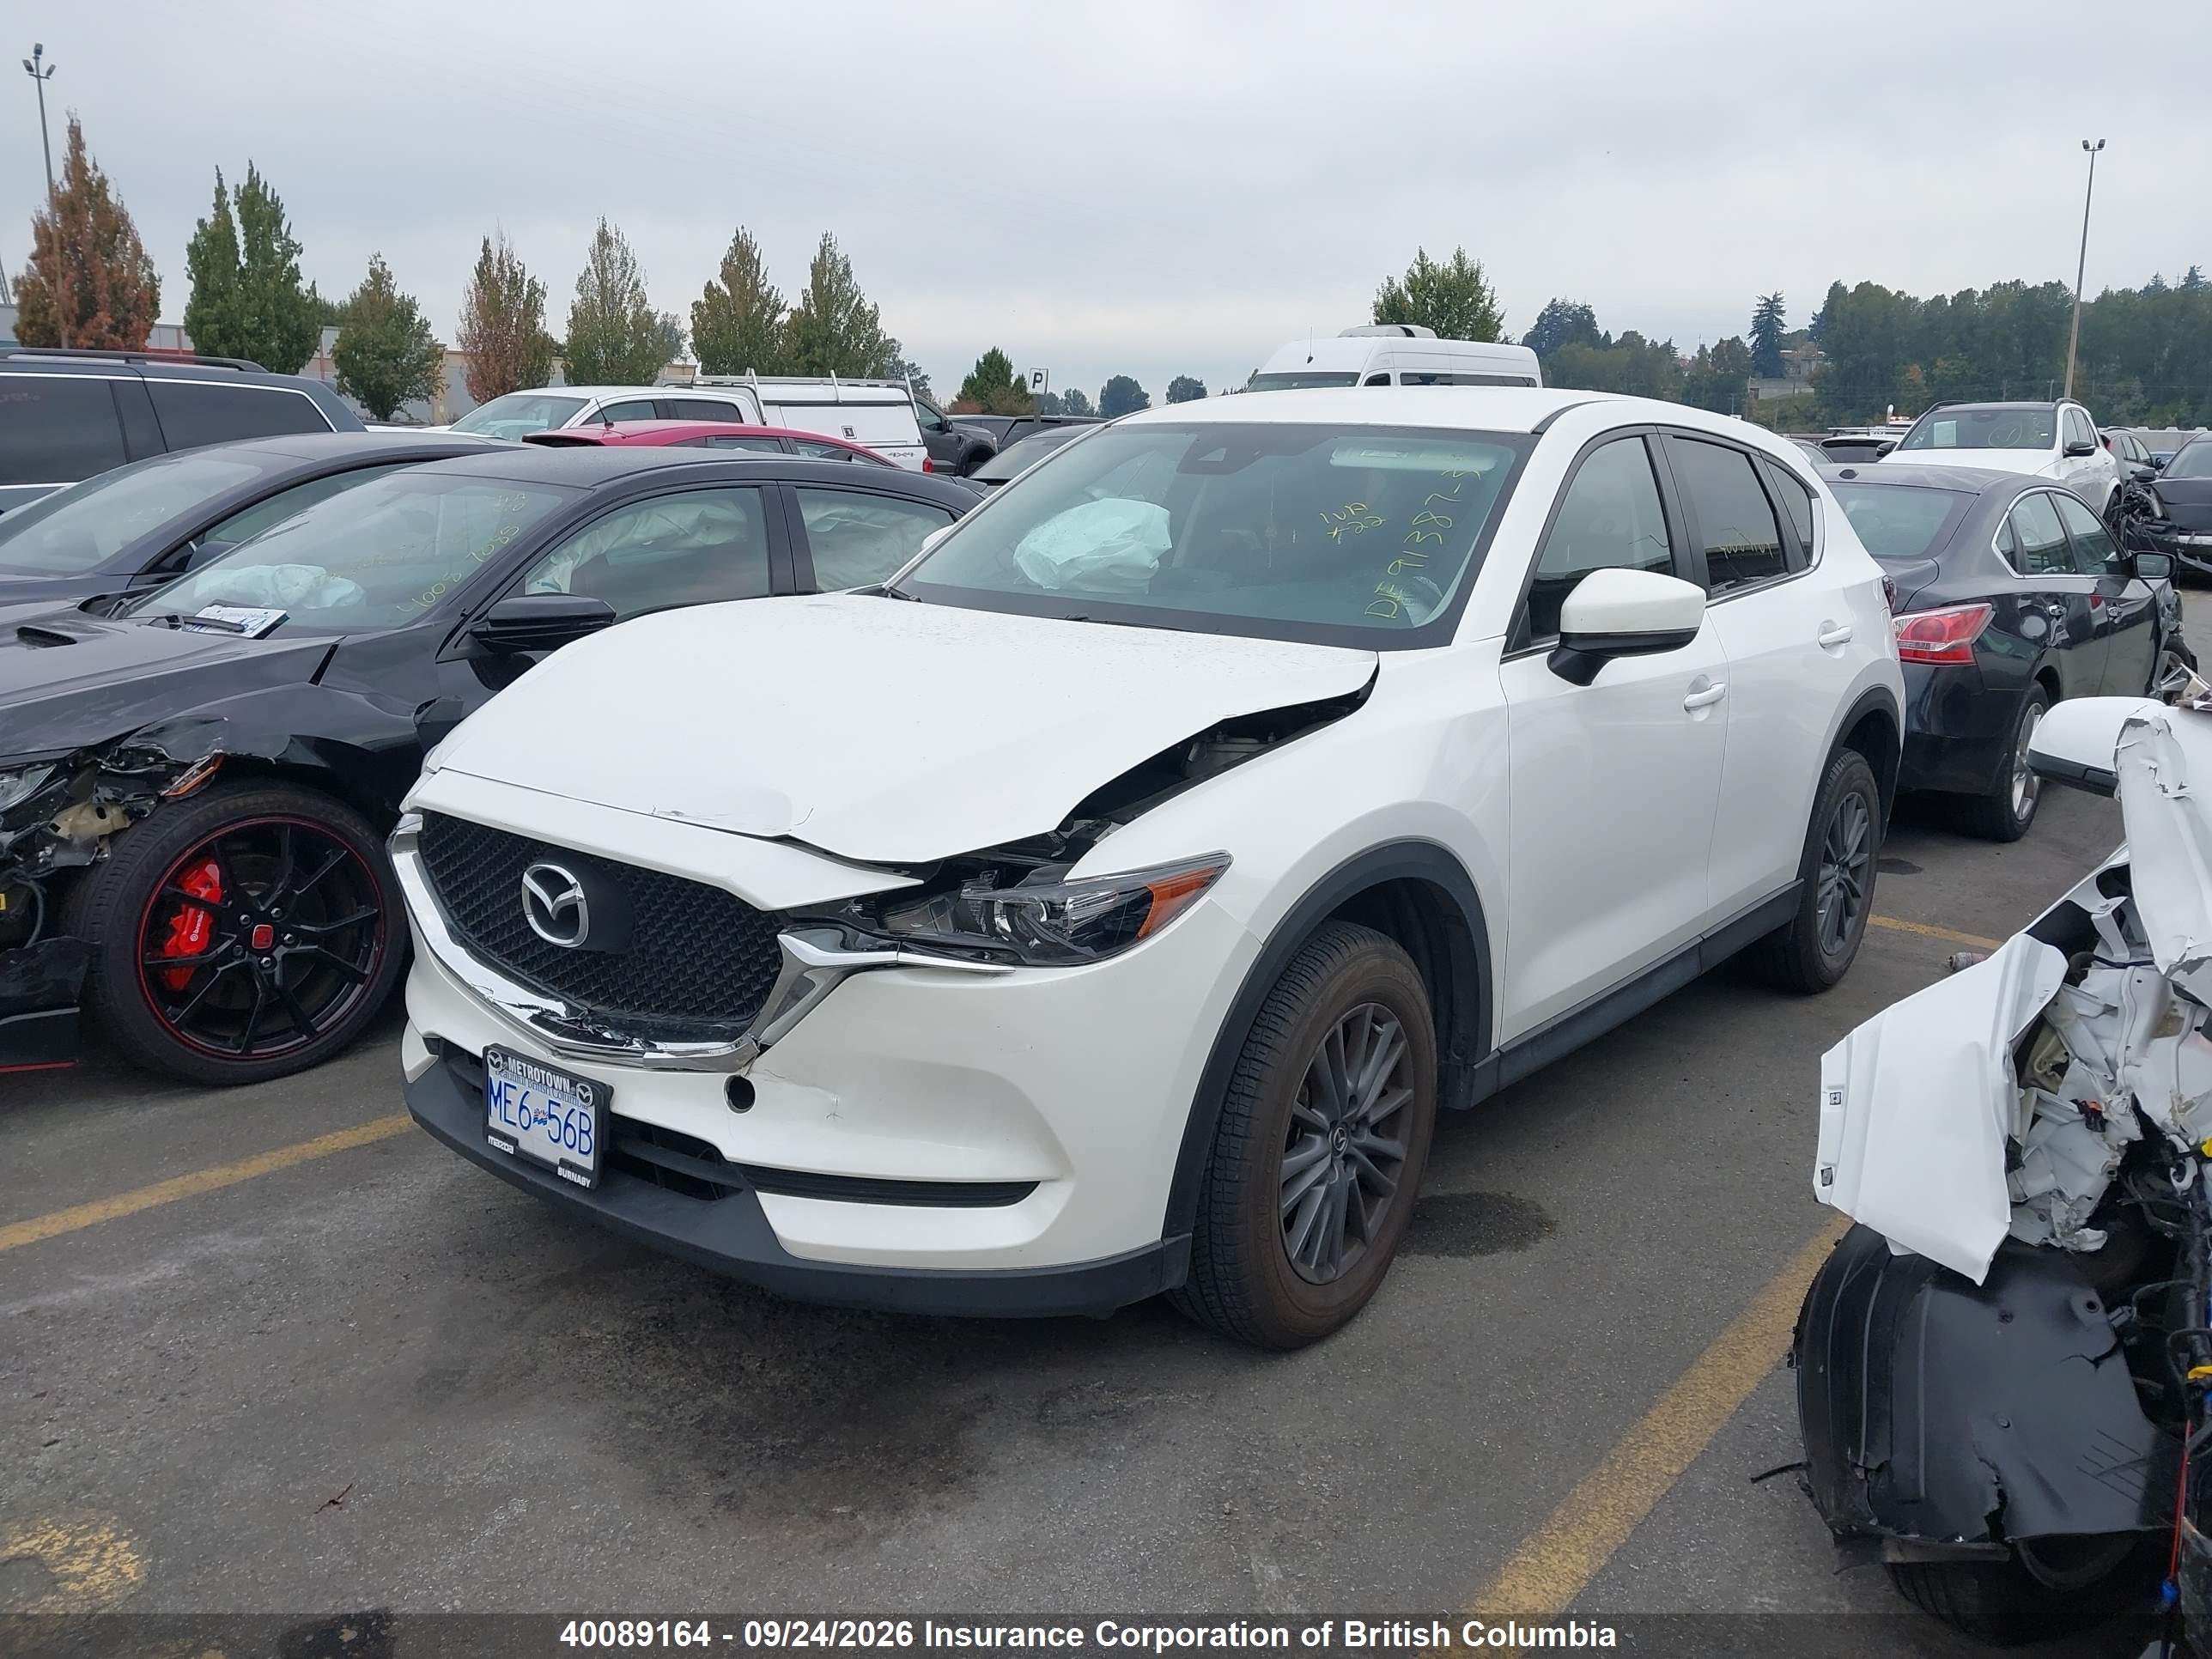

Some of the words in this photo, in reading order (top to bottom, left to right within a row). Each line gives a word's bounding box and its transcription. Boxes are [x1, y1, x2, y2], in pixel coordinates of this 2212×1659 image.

[1031, 372, 1043, 389] P
[507, 1056, 570, 1093] METROTOWN
[489, 1076, 532, 1131] ME6
[547, 1098, 592, 1156] 56B
[557, 1166, 591, 1188] BURNABY
